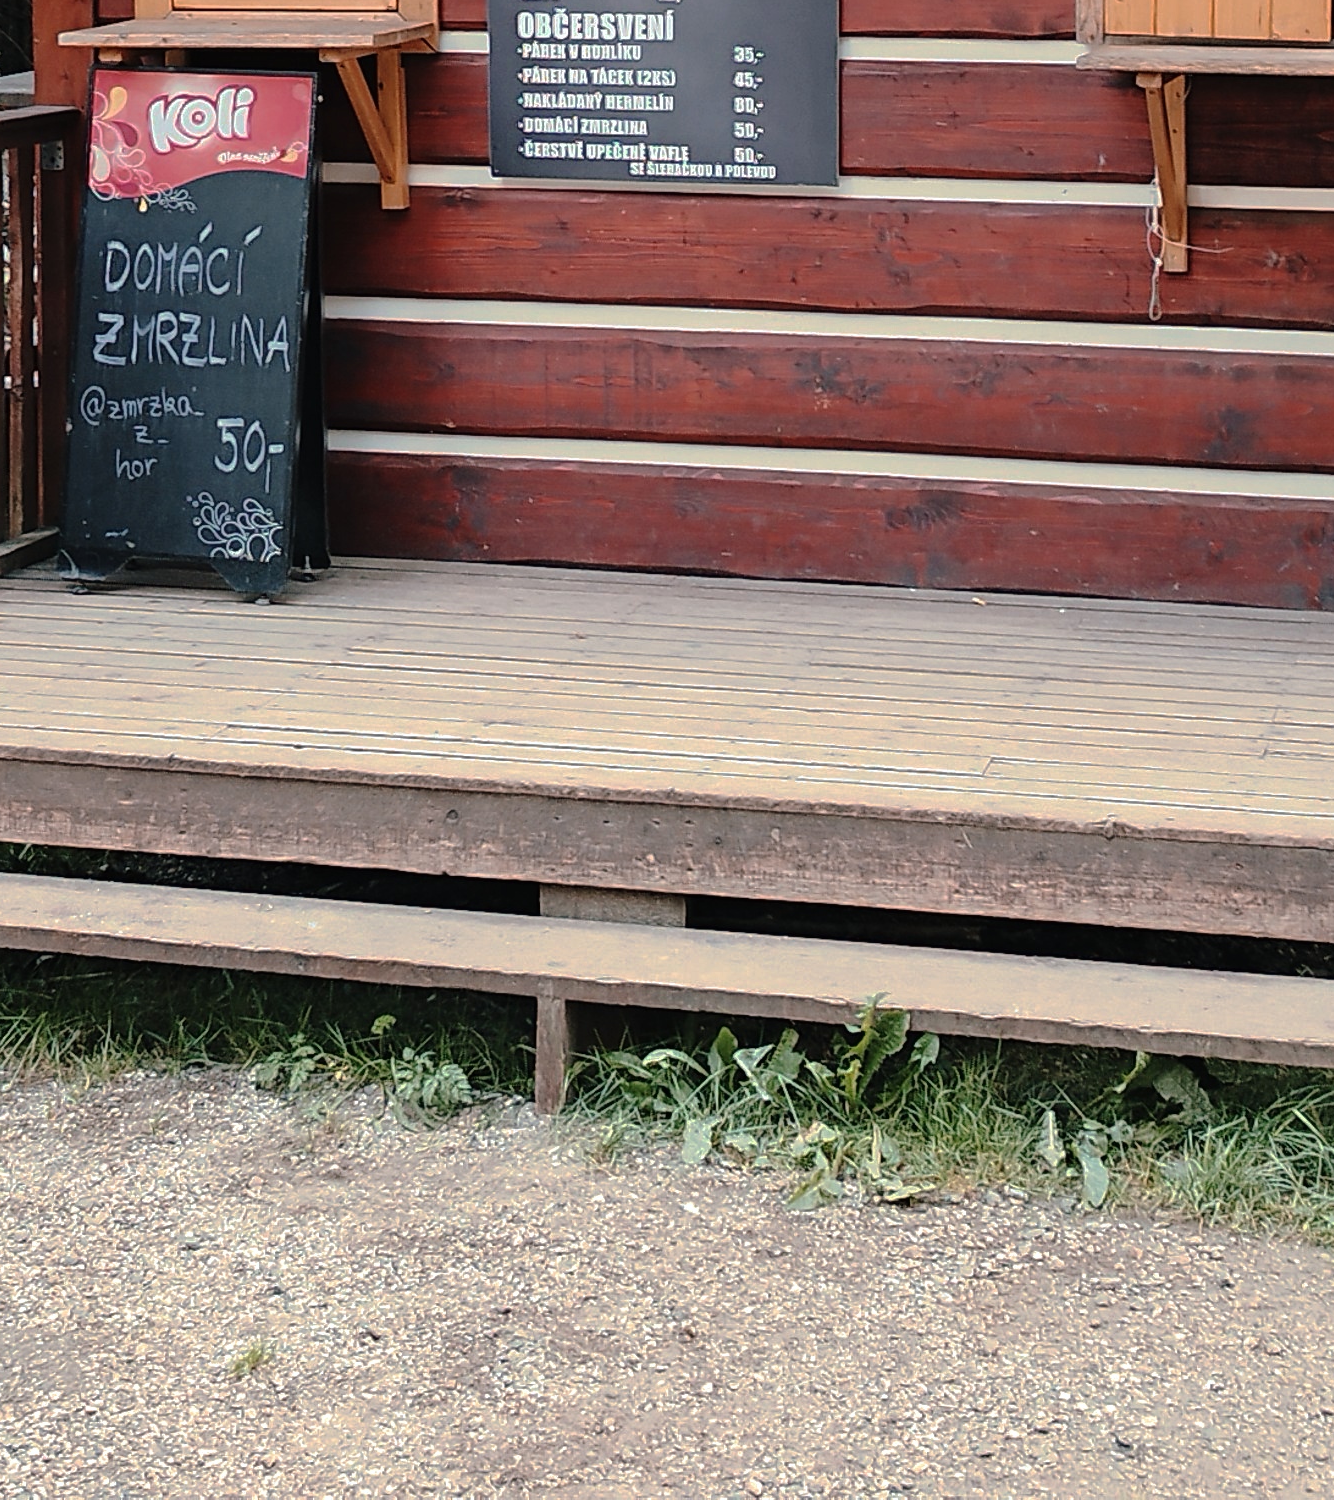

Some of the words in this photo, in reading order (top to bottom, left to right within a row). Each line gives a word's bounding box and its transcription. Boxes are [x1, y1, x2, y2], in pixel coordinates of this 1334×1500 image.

[517, 7, 675, 41] OBČERSVENÍ
[522, 41, 566, 60] PÁREK
[569, 44, 579, 60] V
[581, 42, 642, 61] ROHLÍKU
[522, 65, 566, 85] PÁREK
[569, 68, 588, 85] NA
[591, 66, 634, 86] TÁCEK
[522, 90, 603, 110] NAKLÁDANÝ
[604, 93, 674, 111] HERMELÍN
[148, 85, 257, 155] Koli
[522, 115, 579, 134] DOMÁCÍ
[580, 118, 648, 135] ZMRZLINA
[647, 145, 689, 162] VAFLE
[629, 162, 645, 176] SE
[104, 221, 263, 298] DOMÁCÍ
[93, 310, 290, 373] ZMRZLINA
[116, 448, 158, 481] hor
